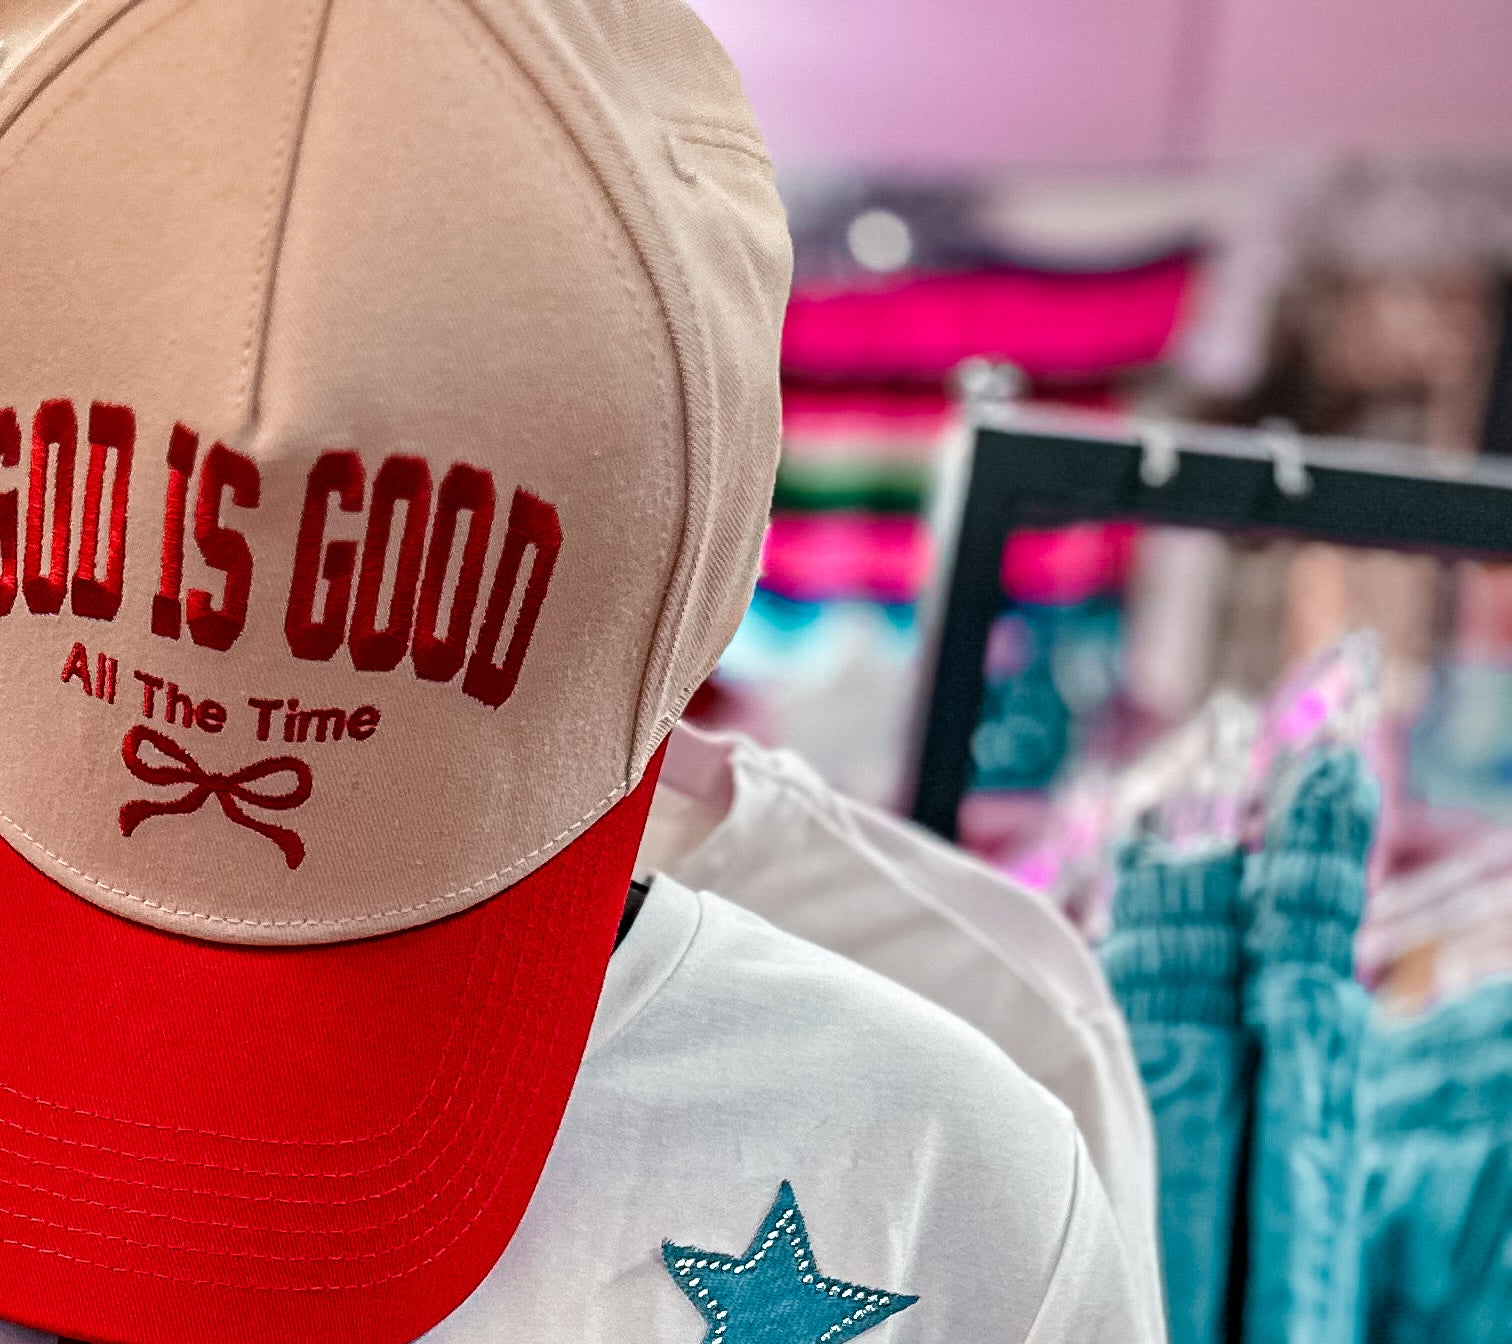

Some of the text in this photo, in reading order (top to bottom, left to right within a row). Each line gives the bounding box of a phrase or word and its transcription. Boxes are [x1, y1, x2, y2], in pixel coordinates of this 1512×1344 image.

[151, 421, 261, 652] IS
[283, 449, 564, 710] GOOD
[59, 641, 380, 742] All The Time
